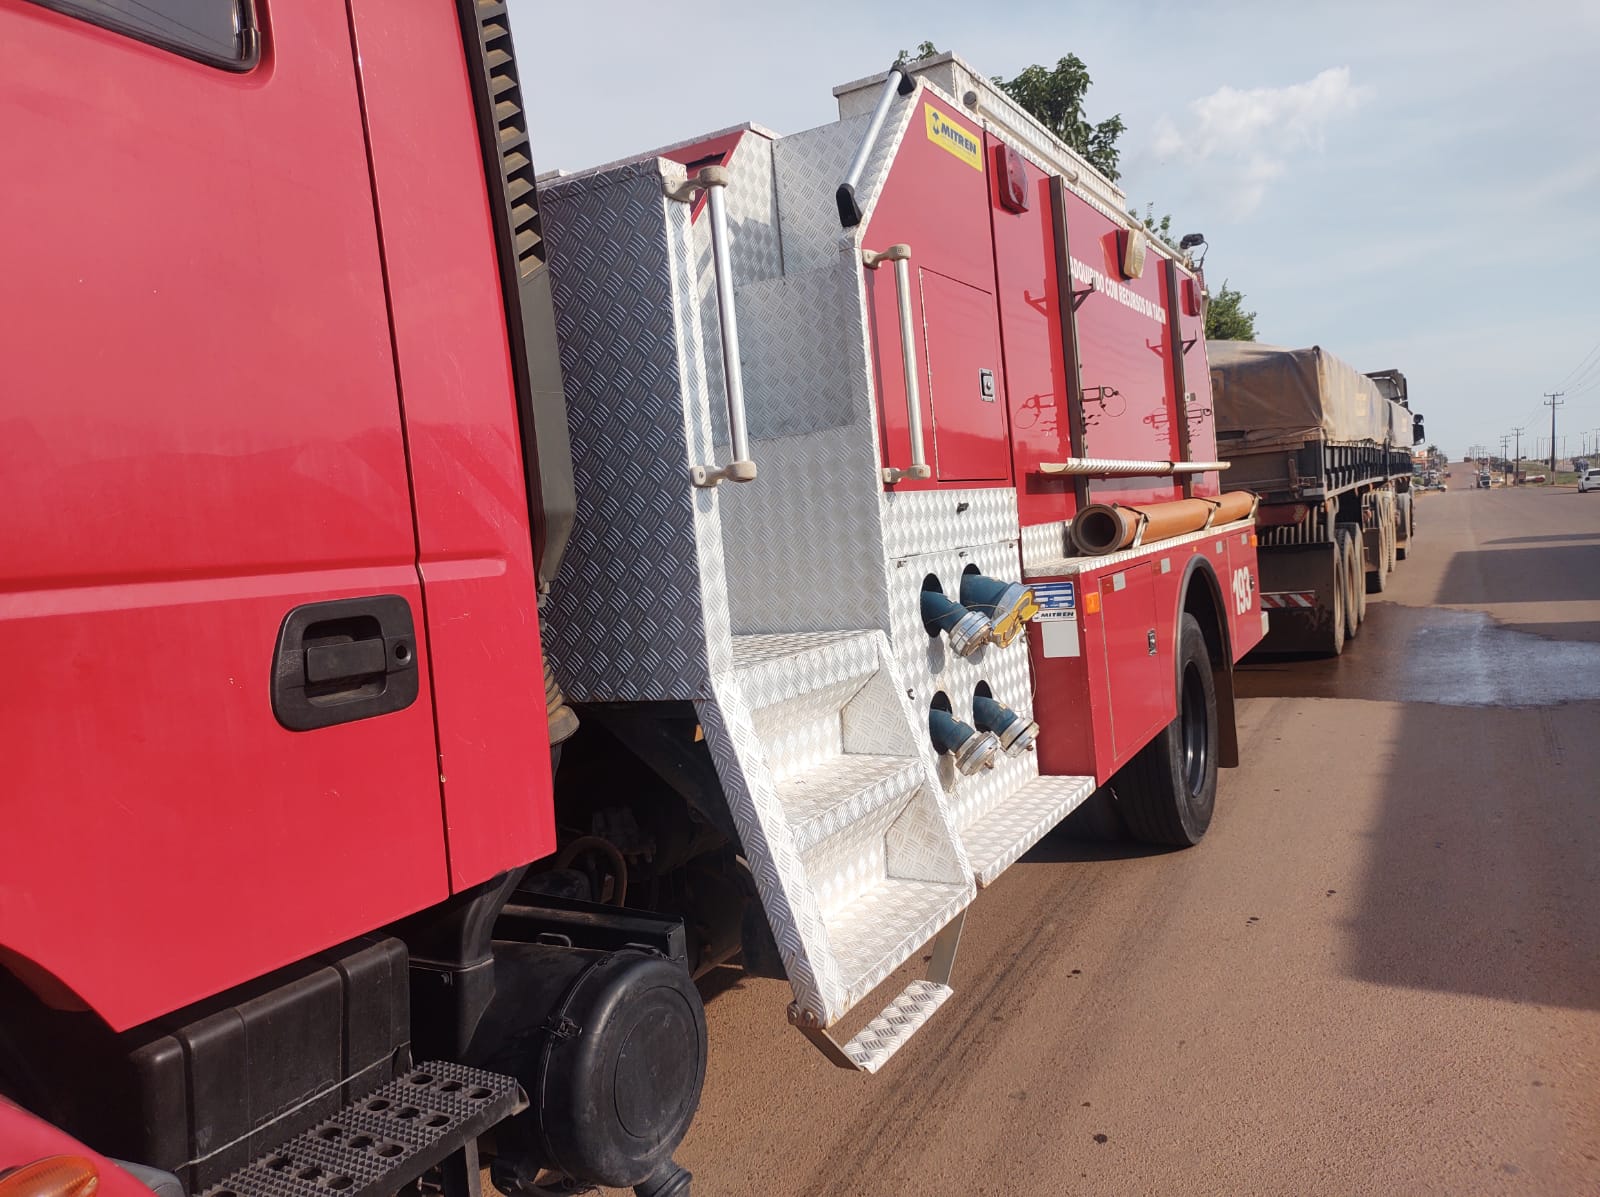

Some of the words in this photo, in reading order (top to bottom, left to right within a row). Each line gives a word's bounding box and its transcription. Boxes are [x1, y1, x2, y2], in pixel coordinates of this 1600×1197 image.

[941, 122, 977, 154] MITREN
[1105, 276, 1119, 301] COM
[1118, 284, 1146, 315] RECURSOS
[1233, 566, 1252, 616] 193
